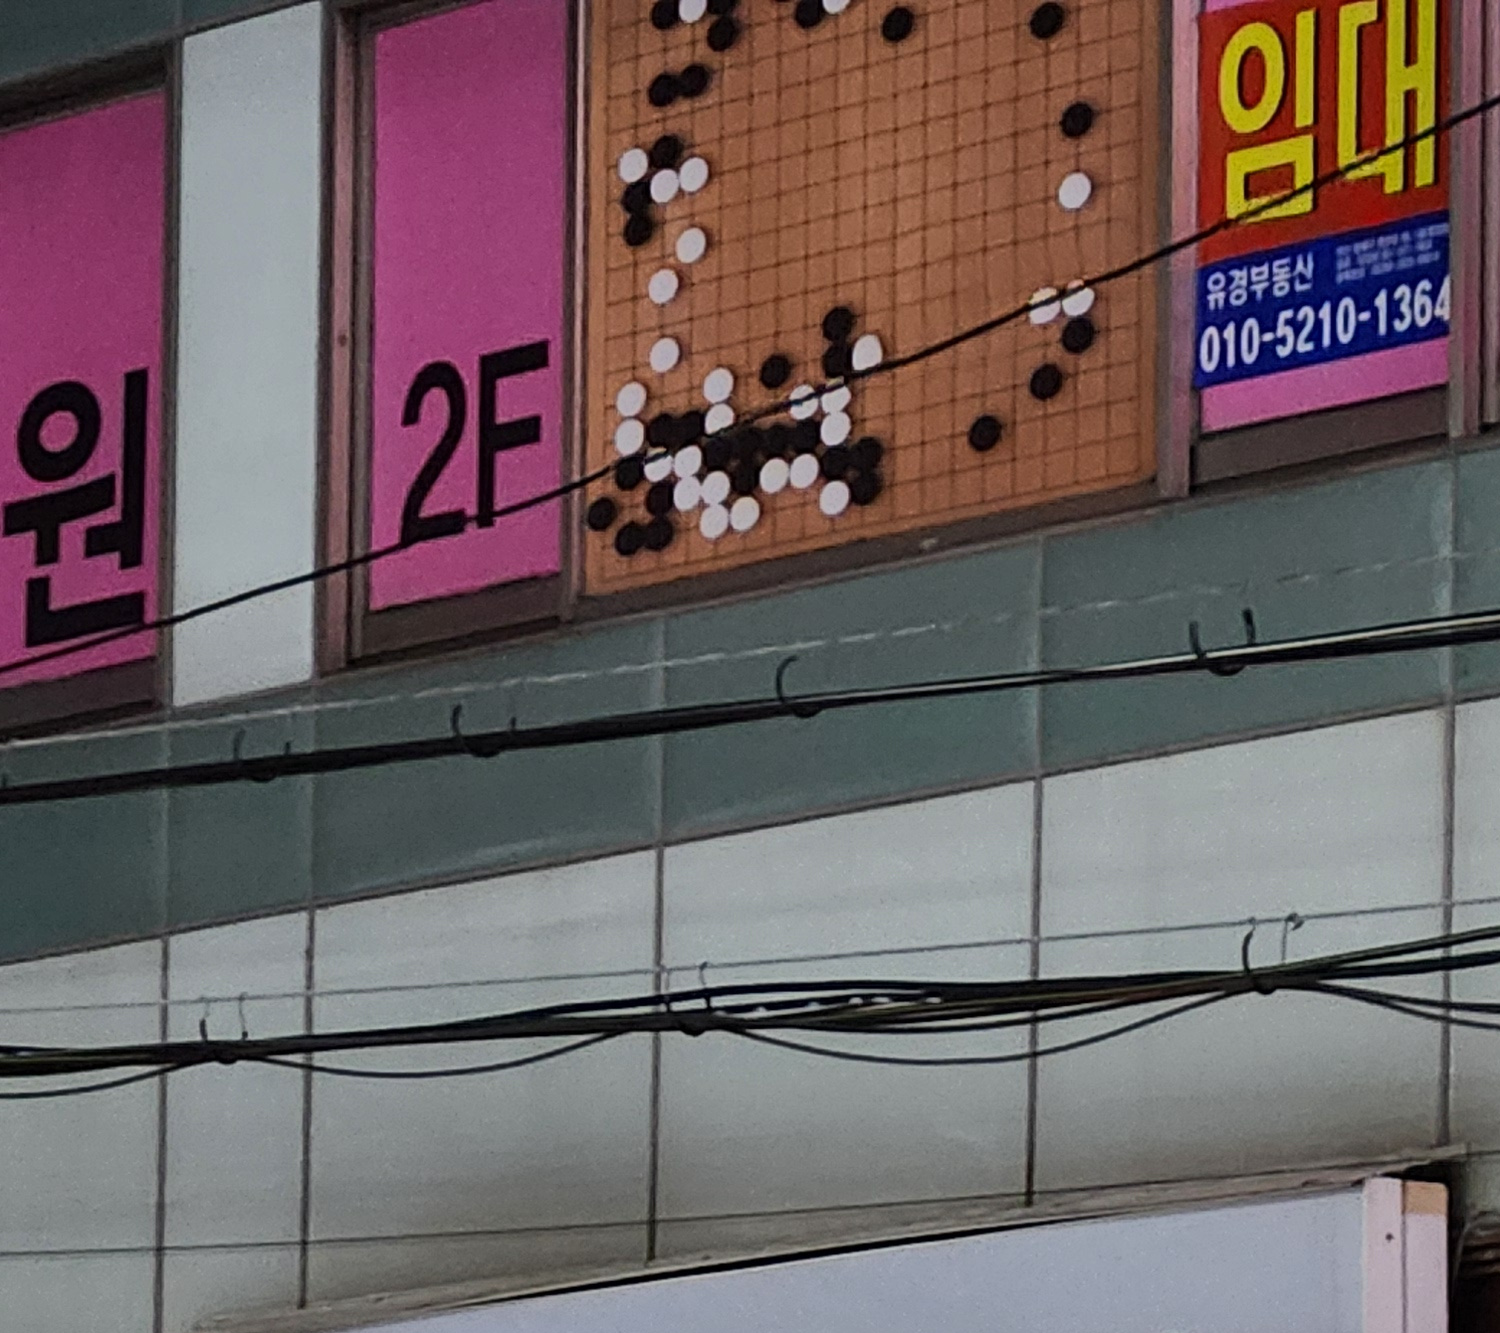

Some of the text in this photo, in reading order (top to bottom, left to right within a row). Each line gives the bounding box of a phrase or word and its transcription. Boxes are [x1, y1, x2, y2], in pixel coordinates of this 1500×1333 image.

[1219, 0, 1437, 223] 임대
[1200, 274, 1451, 373] 010-5210-1364
[2, 367, 149, 647] 원
[400, 340, 550, 543] 2F
